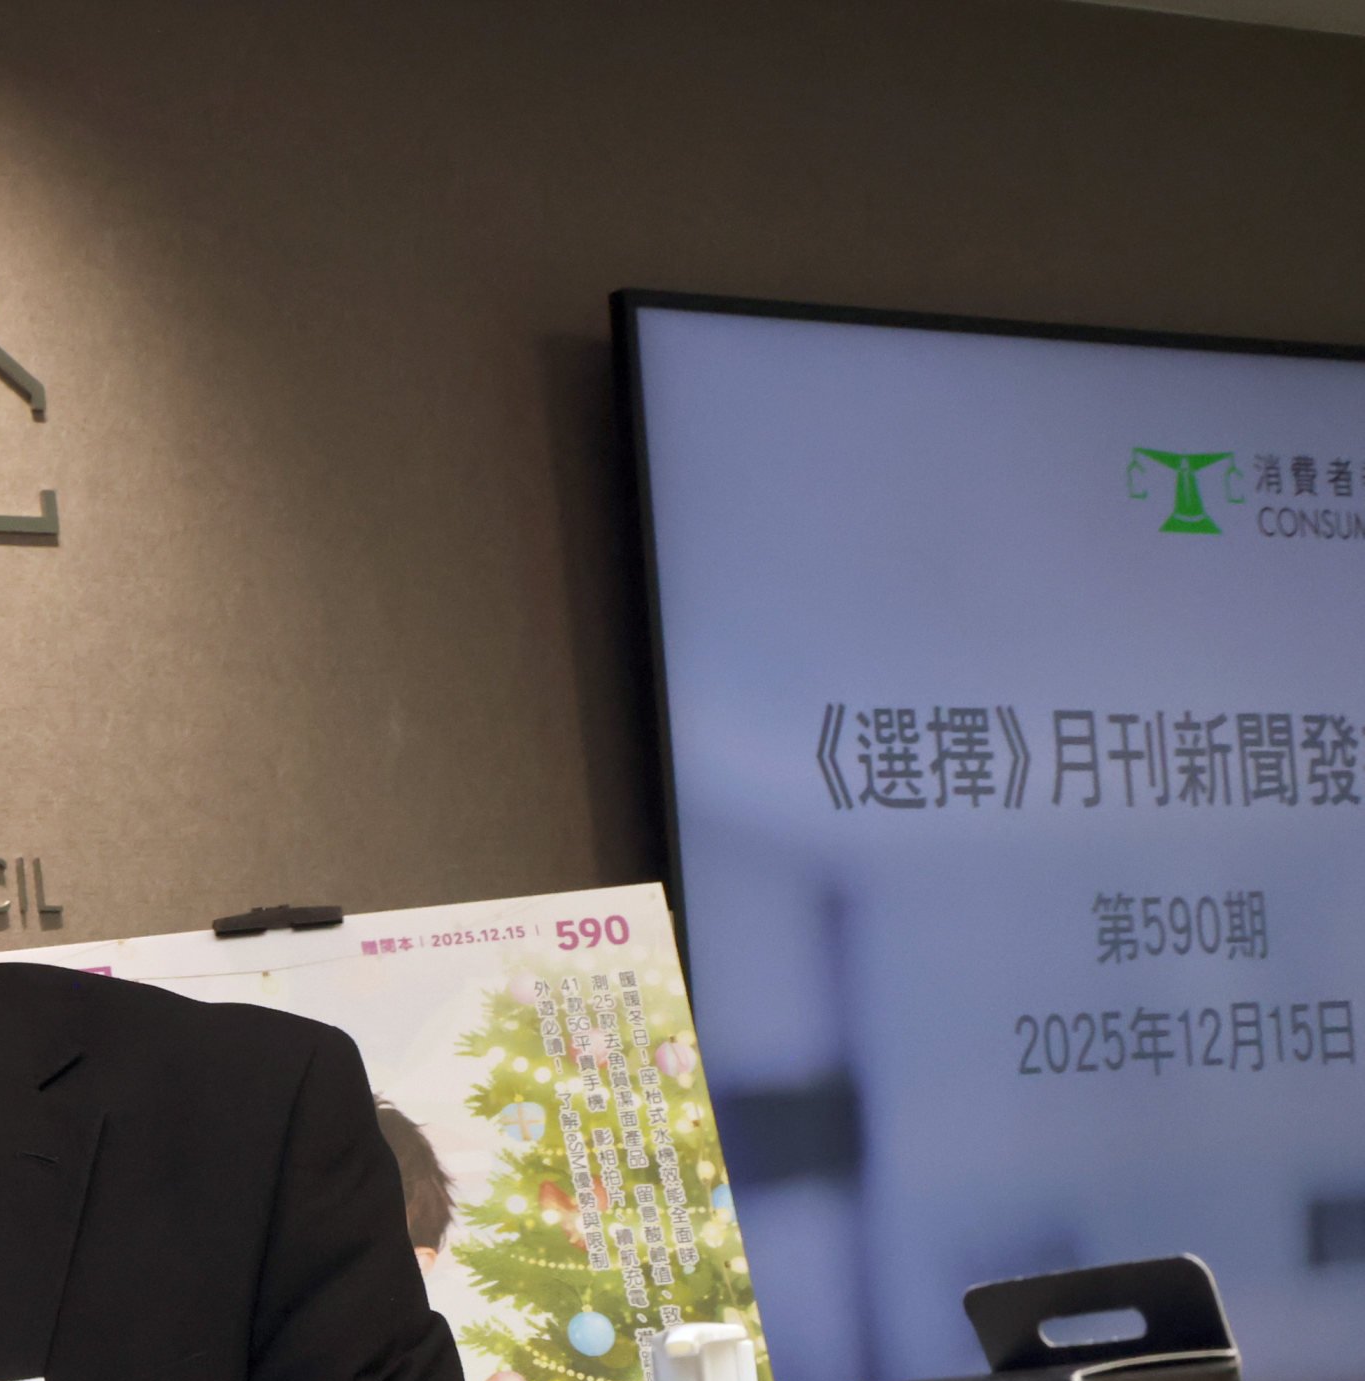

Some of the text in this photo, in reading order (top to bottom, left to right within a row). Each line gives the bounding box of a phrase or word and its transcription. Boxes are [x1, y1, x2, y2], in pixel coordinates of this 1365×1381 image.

[431, 925, 526, 947] 2025.12.15
[556, 914, 631, 951] 590
[1091, 891, 1269, 963] 第590期
[1015, 999, 1357, 1075] 2025年12月15日
